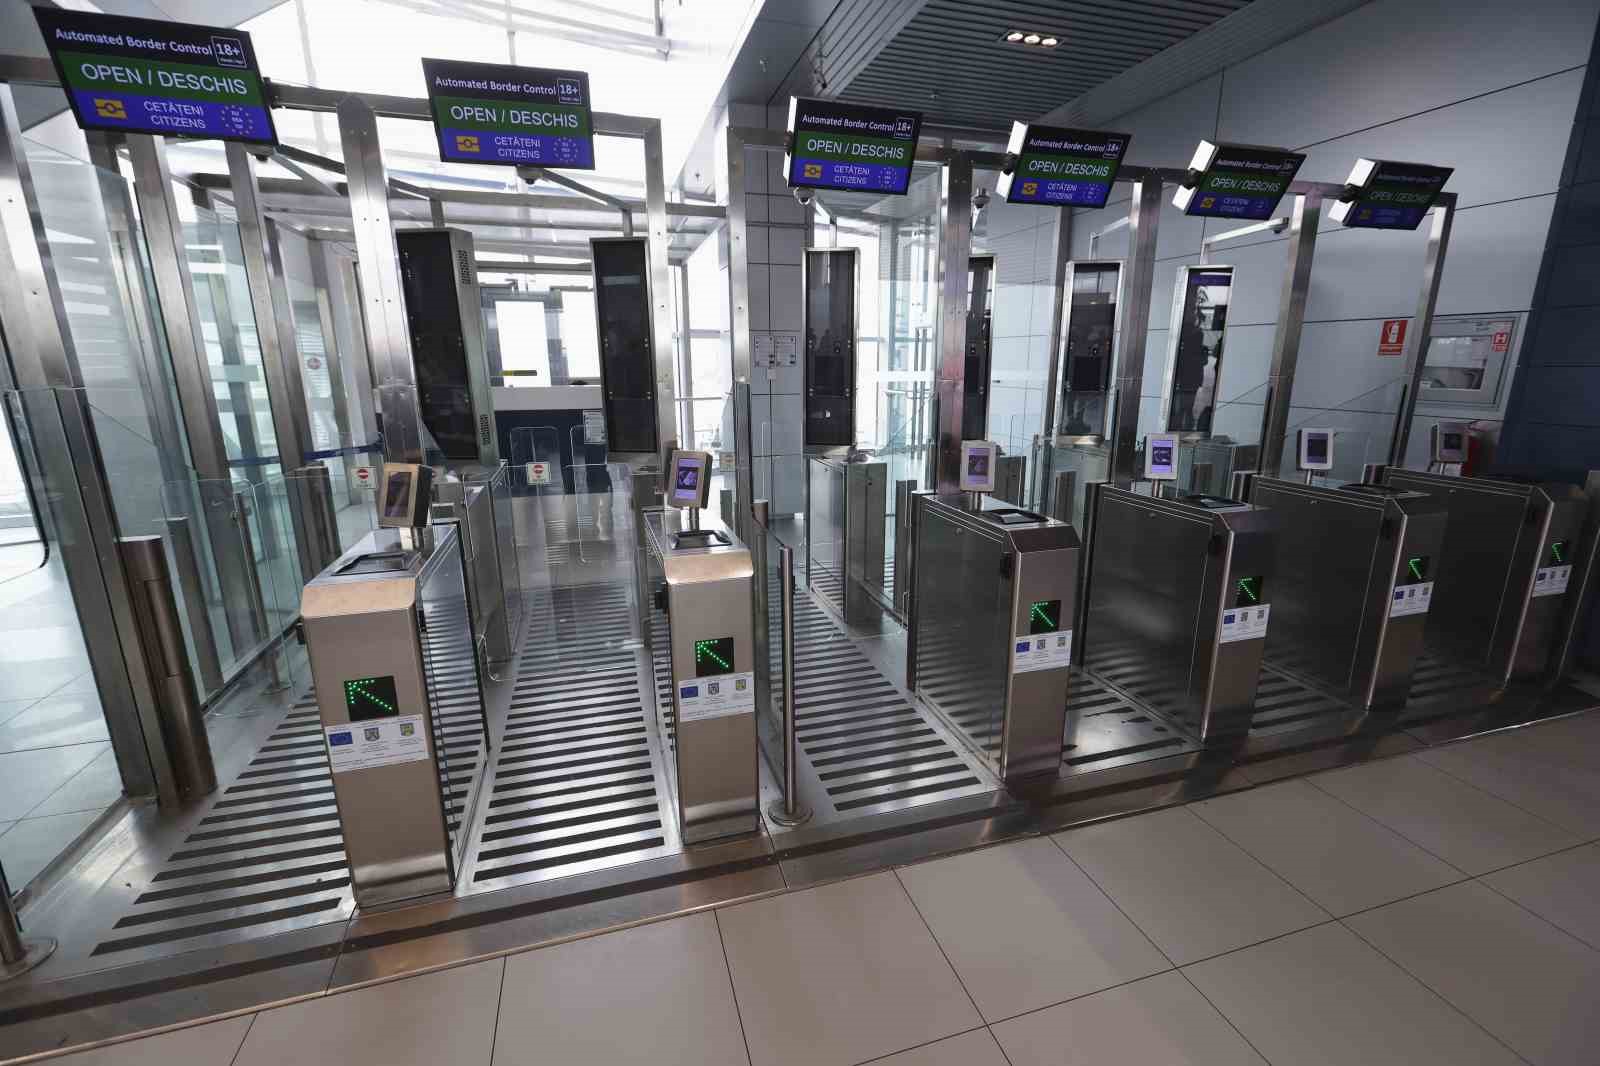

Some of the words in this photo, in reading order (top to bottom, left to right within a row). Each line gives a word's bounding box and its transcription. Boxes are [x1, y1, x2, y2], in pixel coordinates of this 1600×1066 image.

[56, 28, 123, 46] Automated
[126, 36, 166, 51] Border
[169, 41, 212, 56] Control
[216, 43, 241, 56] 18+
[81, 63, 143, 85] OPEN
[158, 71, 247, 95] DESCHIS
[435, 76, 487, 90] Automated
[490, 81, 521, 93] Border
[523, 83, 557, 96] Control
[559, 84, 578, 95] 18+
[150, 115, 206, 129] CITIZENS
[450, 105, 497, 122] OPEN
[510, 110, 579, 128] DESCHIS
[802, 114, 843, 127] Automated
[844, 118, 867, 129] Border
[869, 121, 895, 132] Control
[897, 122, 911, 132] 18+
[807, 138, 842, 153] OPEN
[851, 143, 904, 159] DESCHIS
[1029, 138, 1062, 149] Automated
[1062, 140, 1084, 151] Border
[1083, 143, 1106, 152] Control
[497, 148, 541, 159] CITIZENS
[1028, 159, 1059, 172] OPEN
[1065, 162, 1110, 177] DESCHIS
[834, 175, 867, 185] CITIZENS
[1210, 177, 1236, 189] OPEN
[1242, 180, 1281, 192] DESCHIS
